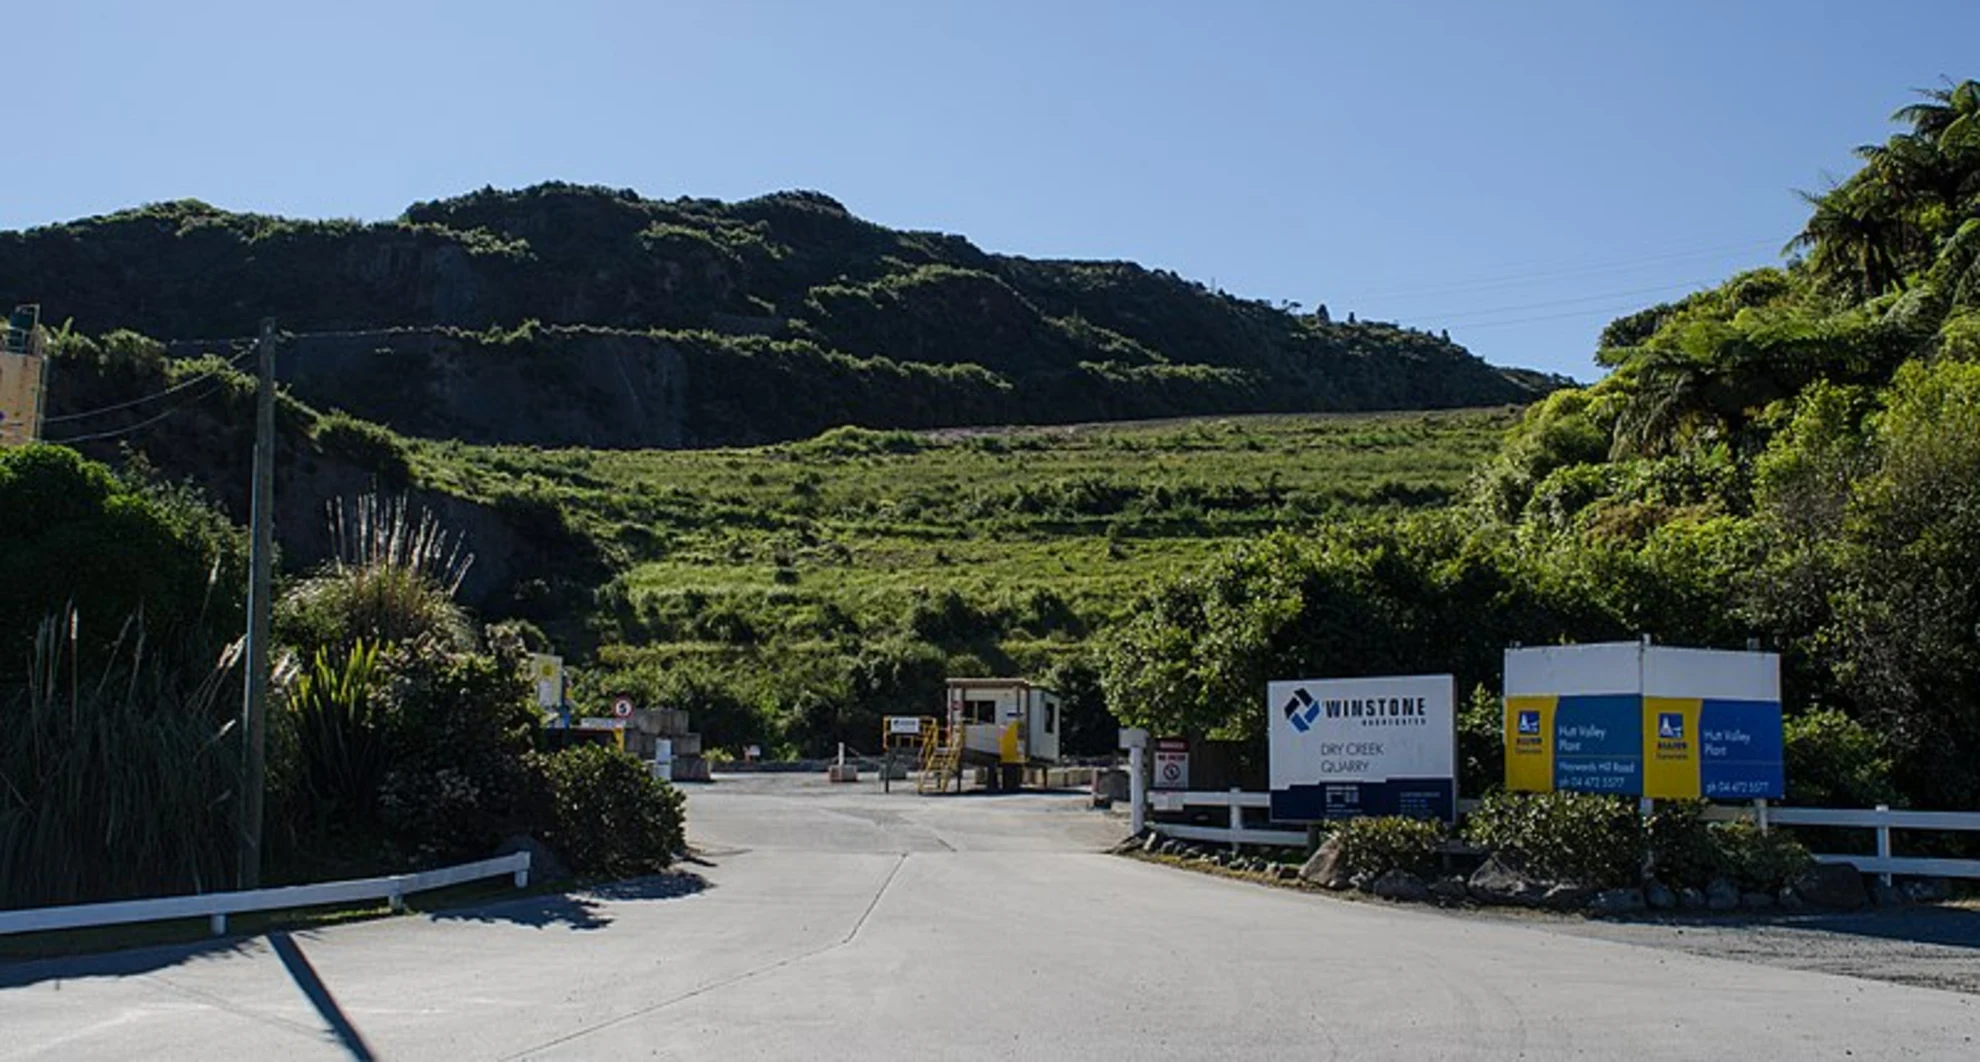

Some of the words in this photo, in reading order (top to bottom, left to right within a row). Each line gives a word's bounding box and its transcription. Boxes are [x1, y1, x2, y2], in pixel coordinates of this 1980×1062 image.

[1325, 697, 1426, 718] WINSTONE
[1558, 724, 1578, 737] Hutt
[1578, 724, 1607, 741] Valley
[1703, 728, 1723, 741] Hutt
[1724, 729, 1751, 745] Valley
[1321, 743, 1345, 756] DRY
[1346, 742, 1385, 756] CREEK
[1558, 739, 1582, 751] Plant
[1704, 743, 1727, 756] Plant
[1321, 760, 1370, 773] QUARRY
[1613, 761, 1635, 773] Road
[1571, 777, 1582, 787] 04
[1718, 780, 1731, 791] 04
